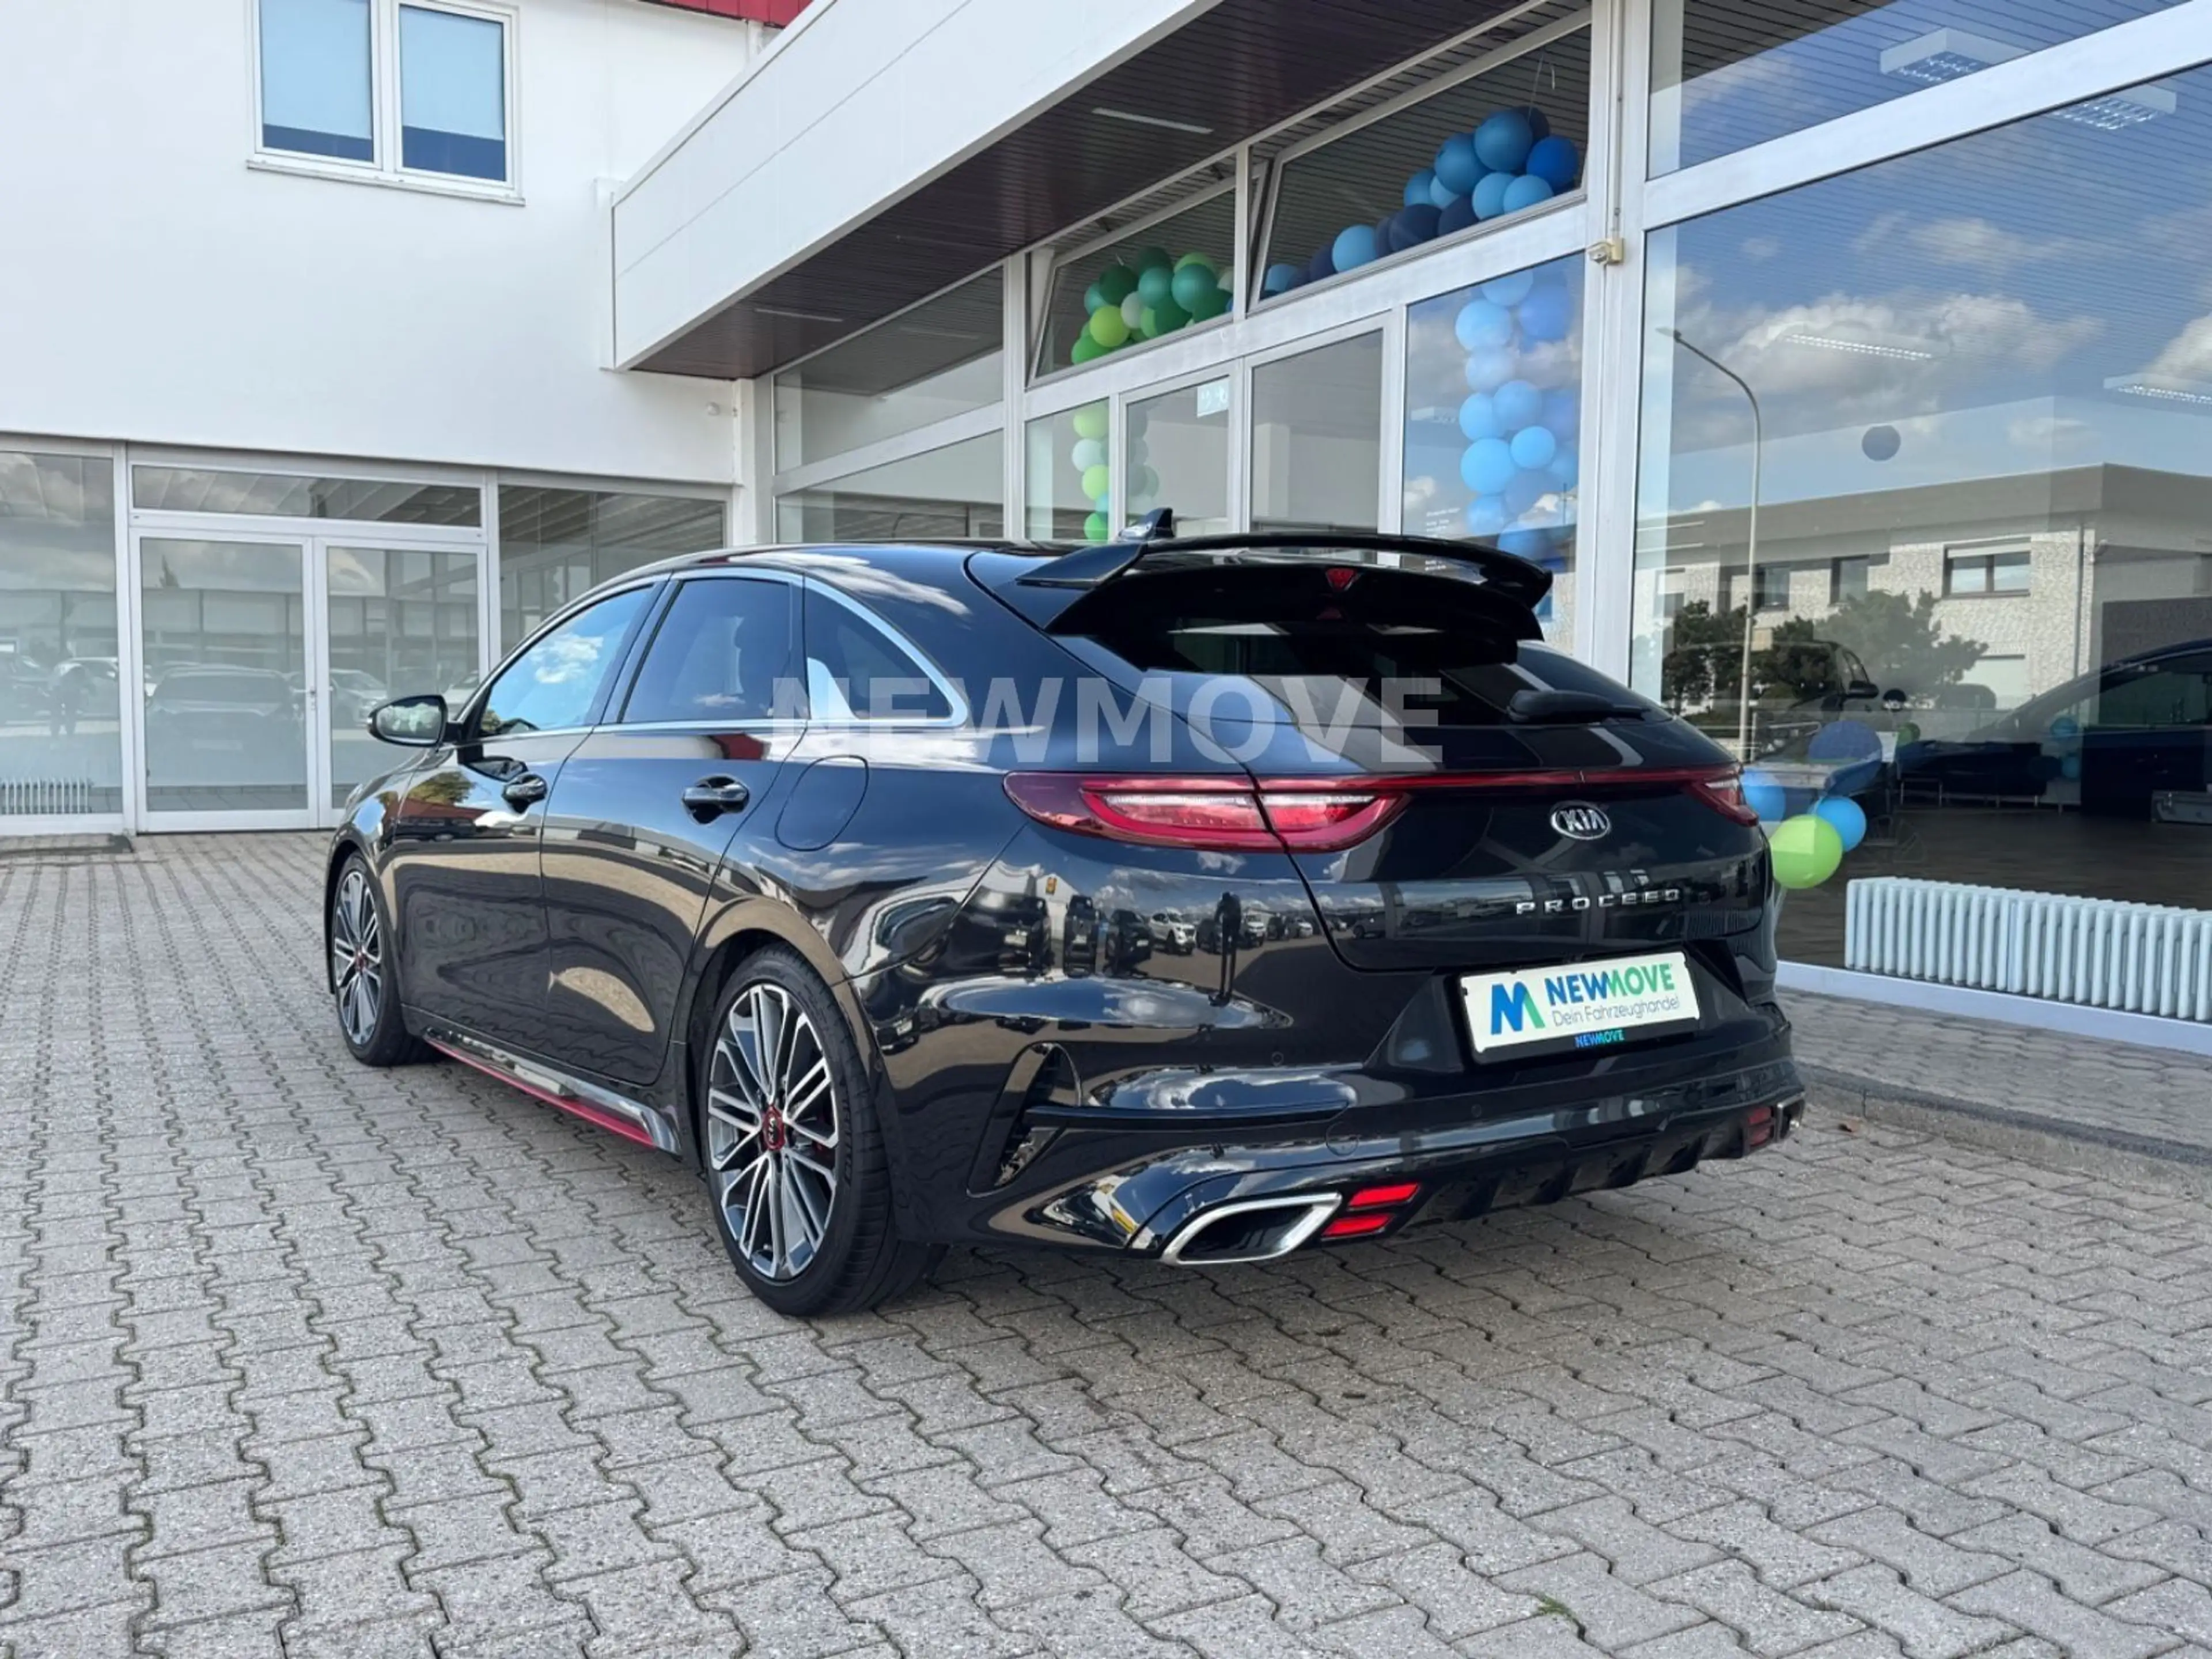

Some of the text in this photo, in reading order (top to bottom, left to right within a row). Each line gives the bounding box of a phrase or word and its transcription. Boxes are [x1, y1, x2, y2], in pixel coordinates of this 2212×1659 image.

[1559, 808, 1606, 832] KIA
[1516, 888, 1680, 915] PROCEED
[1544, 963, 1676, 1006] NEWMOVE
[1551, 996, 1680, 1028] Dein Fahrzeughandel
[1574, 1029, 1625, 1048] NEWMOVE
